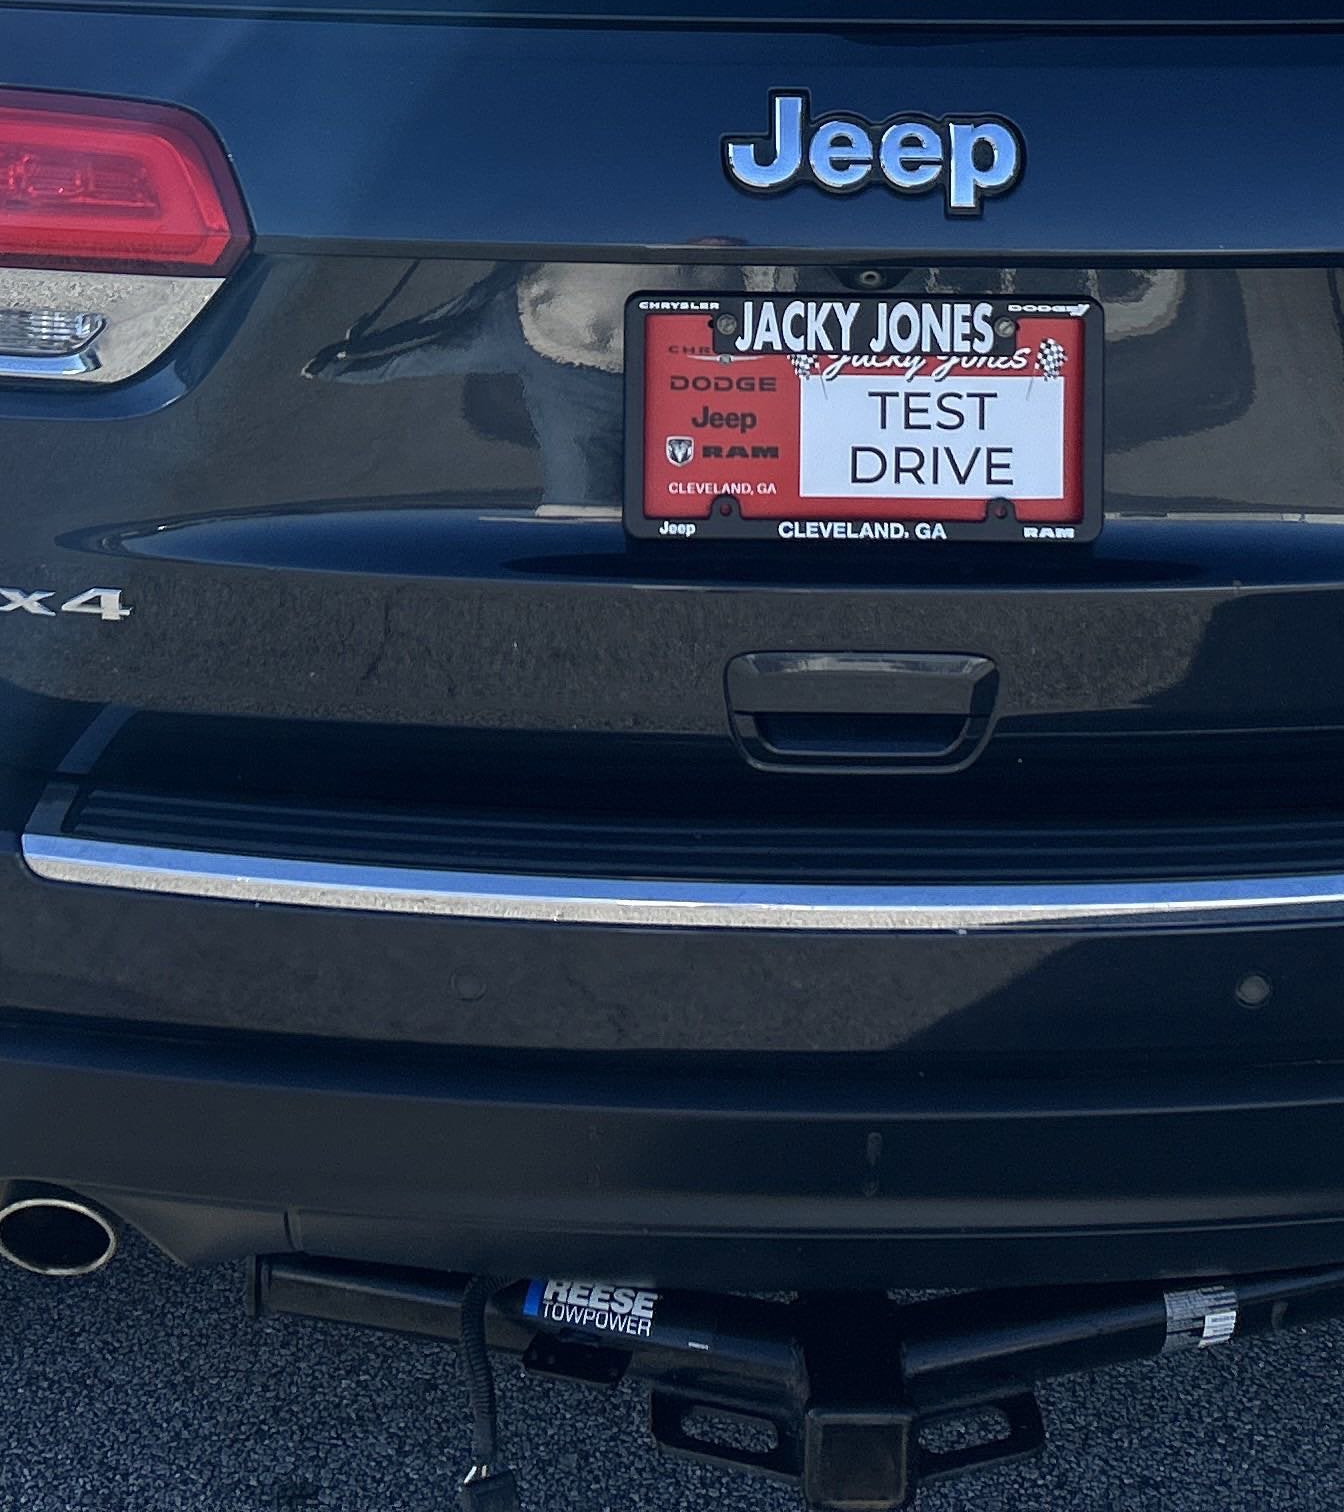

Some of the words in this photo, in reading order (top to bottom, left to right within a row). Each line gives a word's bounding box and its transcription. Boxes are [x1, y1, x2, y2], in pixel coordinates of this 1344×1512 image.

[725, 94, 1019, 210] Jeep
[638, 300, 720, 310] CHRYSLER
[734, 300, 860, 352] JACKY
[869, 301, 994, 354] JONES
[669, 375, 777, 392] DODGE
[691, 405, 757, 434] Jeep
[867, 391, 999, 431] TEST
[702, 445, 780, 459] RAM
[850, 445, 1015, 486] DRIVE
[668, 482, 754, 496] CLEVELAND,
[756, 482, 777, 495] GA
[659, 520, 697, 537] Jeep
[914, 522, 948, 541] GA
[1023, 526, 1076, 539] RAM
[542, 1279, 658, 1320] REESE
[542, 1300, 652, 1337] TOWPOWER
